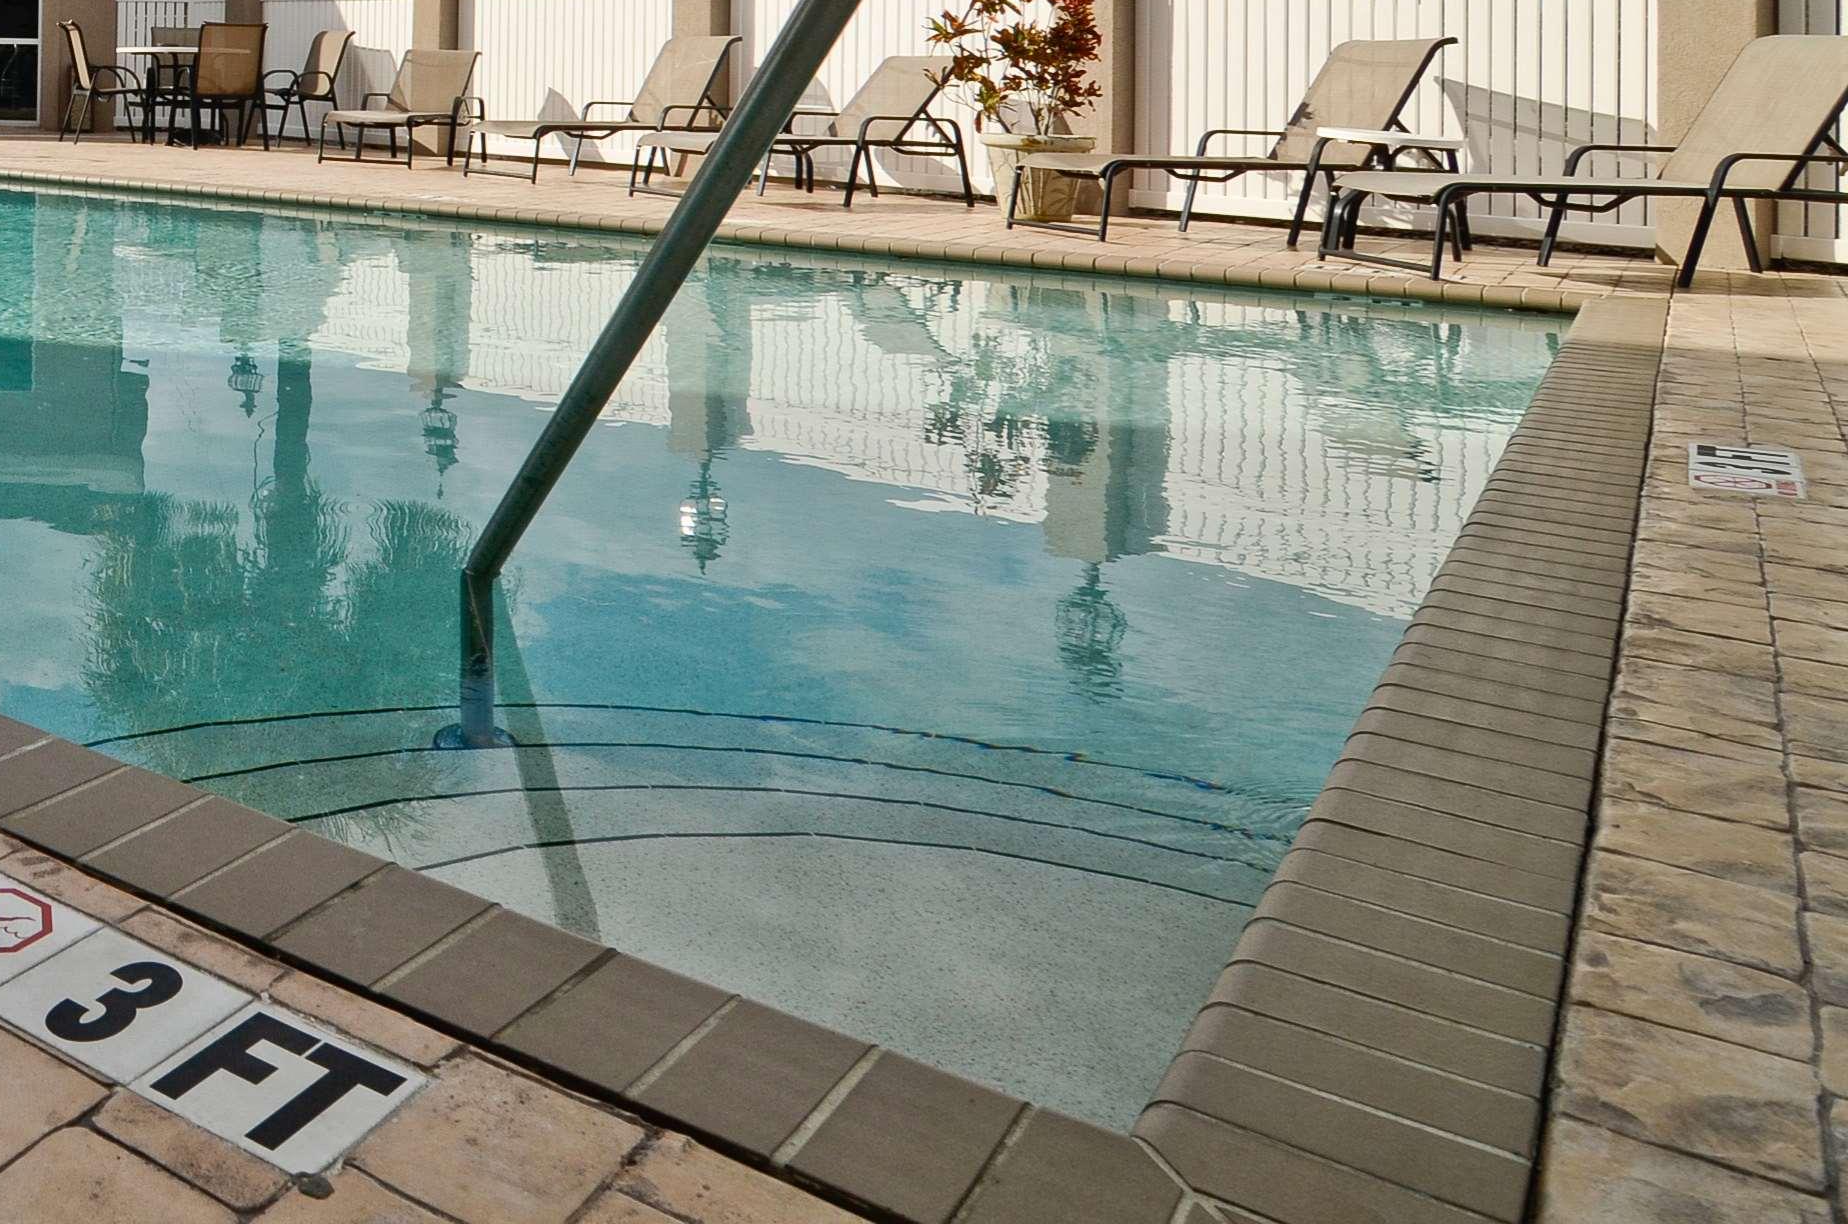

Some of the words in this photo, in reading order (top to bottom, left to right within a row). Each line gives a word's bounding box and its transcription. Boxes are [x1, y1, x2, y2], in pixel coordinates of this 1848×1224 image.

[1697, 444, 1790, 466] FT
[45, 961, 183, 1042] 3
[150, 1011, 407, 1151] FT
